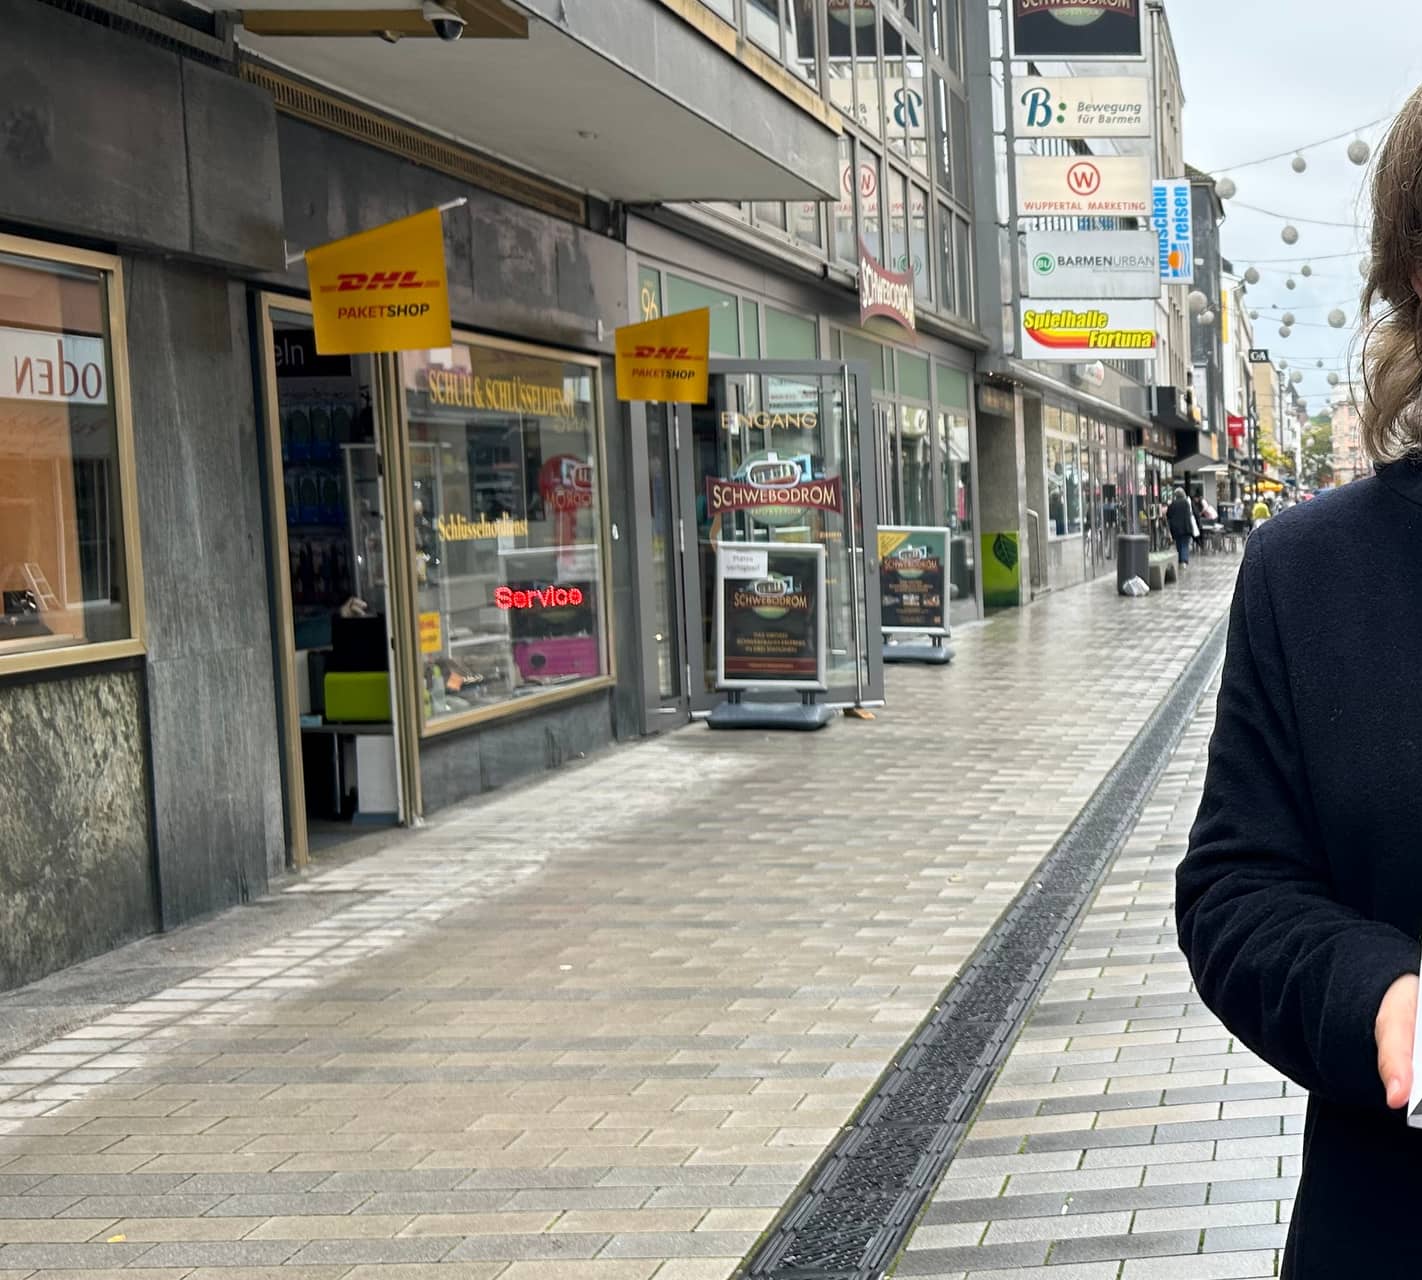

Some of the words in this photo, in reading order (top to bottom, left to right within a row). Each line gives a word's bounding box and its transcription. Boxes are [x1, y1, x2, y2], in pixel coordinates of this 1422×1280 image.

[1077, 101, 1142, 114] Bewegung
[1078, 115, 1094, 124] für
[1098, 114, 1142, 124] Barmen
[1024, 202, 1082, 211] WUPPERTAL
[1088, 202, 1146, 211] MARKETING
[1172, 186, 1189, 240] reisen
[335, 271, 423, 292] DHL
[337, 304, 430, 320] PAKETSHOP
[1024, 310, 1109, 330] Spielhalle
[1088, 331, 1153, 348] Fortuna
[633, 346, 692, 360] DHL
[632, 367, 695, 381] PAKETSHOP
[428, 370, 473, 409] SCHUH
[473, 376, 485, 408] &
[721, 411, 817, 429] EINGANG
[713, 484, 837, 509] SCHWEBODROM
[438, 512, 529, 541] Schlüsselnotdienst
[494, 585, 583, 609] Service
